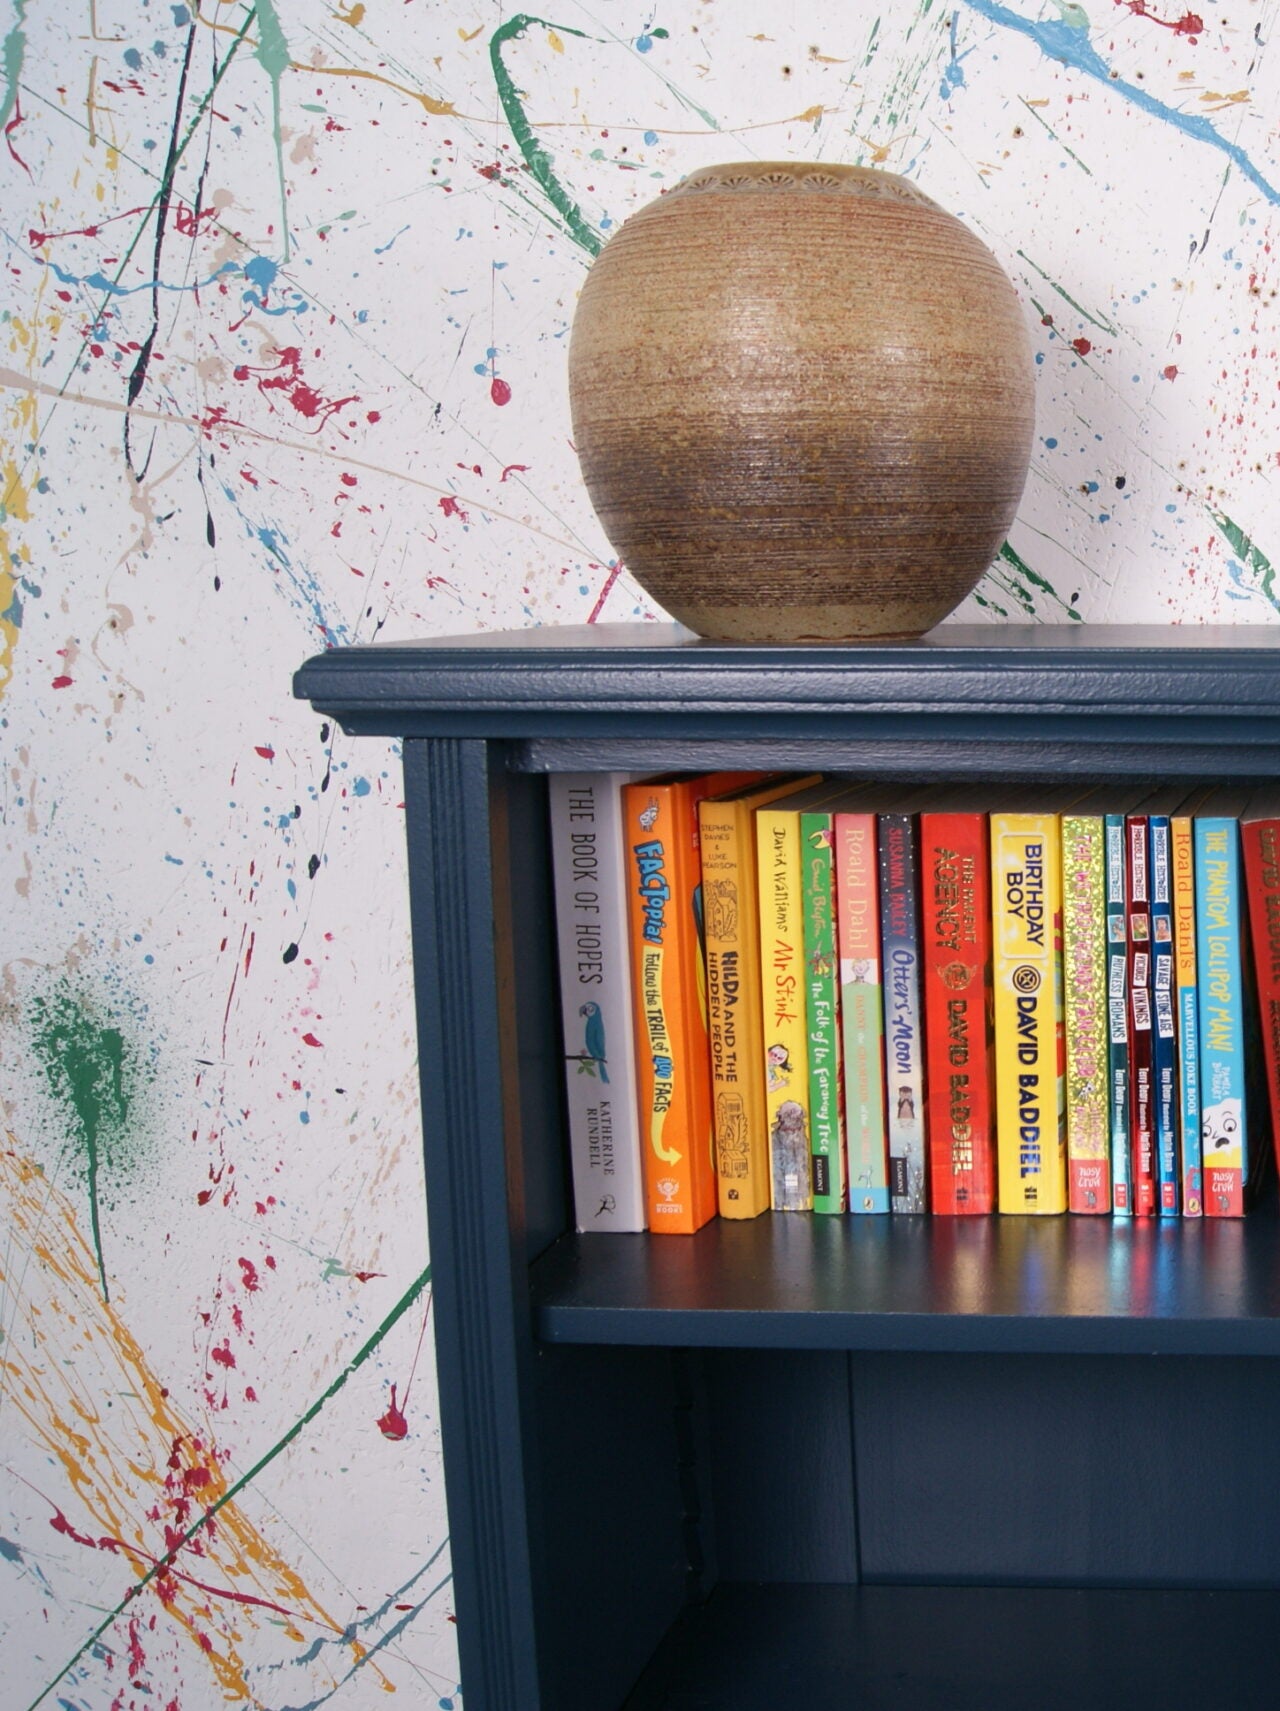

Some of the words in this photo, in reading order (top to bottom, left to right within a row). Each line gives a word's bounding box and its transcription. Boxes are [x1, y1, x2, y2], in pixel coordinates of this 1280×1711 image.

[568, 787, 594, 822] THE
[700, 824, 734, 832] STEPHEN
[705, 833, 730, 841] DAVIES
[773, 827, 787, 866] David
[1205, 830, 1228, 853] THE
[571, 833, 598, 881] BOOK
[703, 861, 737, 869] PEARSON
[846, 829, 866, 887] Roald
[888, 827, 905, 888] SUSANNA
[962, 856, 975, 884] THE
[1176, 833, 1192, 892] Roald
[1259, 828, 1280, 889] DAVID
[575, 892, 600, 913] OF
[774, 871, 788, 932] Walliams
[933, 847, 960, 951] AGENCY
[1006, 871, 1024, 919] BOY
[1025, 844, 1044, 947] BIRTHDAY
[1204, 860, 1230, 931] PHANTOM
[812, 896, 827, 938] Blyton
[849, 899, 868, 949] Dahl
[890, 893, 908, 937] BAILEY
[962, 888, 977, 944] PARENT
[576, 925, 603, 984] HOPES
[773, 939, 794, 971] Mr
[1178, 905, 1194, 969] Dahl's
[645, 953, 660, 988] Follow
[708, 952, 721, 1018] HIDDEN
[721, 951, 739, 1006] HILDA
[892, 949, 915, 1015] Otters'
[1110, 957, 1124, 993] RUTHLESS
[1135, 956, 1146, 981] VICIOUS
[1157, 958, 1170, 985] SAVAGE
[1207, 936, 1232, 1002] LOLLIPOP
[645, 989, 660, 1006] the
[775, 975, 797, 1028] Stink
[811, 981, 823, 999] The
[1134, 990, 1149, 1024] VIKINGS
[1157, 994, 1170, 1016] STONE
[647, 1009, 665, 1043] TRAIL
[723, 1010, 736, 1048] AND
[814, 1000, 830, 1029] Folk
[947, 999, 969, 1067] DAVID
[1017, 997, 1039, 1065] DAVID
[1111, 1001, 1125, 1038] ROMANS
[1160, 1019, 1171, 1032] AGE
[1184, 993, 1196, 1065] MARVELLOUS
[1206, 1005, 1235, 1052] MAN!
[653, 1042, 669, 1053] of
[712, 1024, 723, 1081] PEOPLE
[811, 1030, 829, 1047] of
[814, 1048, 830, 1064] the
[892, 1014, 914, 1074] Moon
[1075, 1035, 1097, 1078] CLUB
[725, 1054, 737, 1082] THE
[1114, 1069, 1125, 1084] Terry
[1138, 1068, 1149, 1083] Terry
[1161, 1068, 1172, 1083] Terry
[1186, 1066, 1196, 1087] JOKE
[654, 1082, 672, 1113] FACTS
[813, 1067, 831, 1120] Faraway
[1115, 1086, 1125, 1104] Deary
[1139, 1085, 1149, 1103] Deary
[1162, 1085, 1172, 1102] Deary
[1187, 1092, 1197, 1116] BOOK
[587, 1108, 600, 1168] RUNDELL
[600, 1101, 615, 1176] KATHERINE
[818, 1121, 832, 1153] Tree
[950, 1074, 973, 1175] BADDIEL
[1018, 1074, 1041, 1178] BADDIEL
